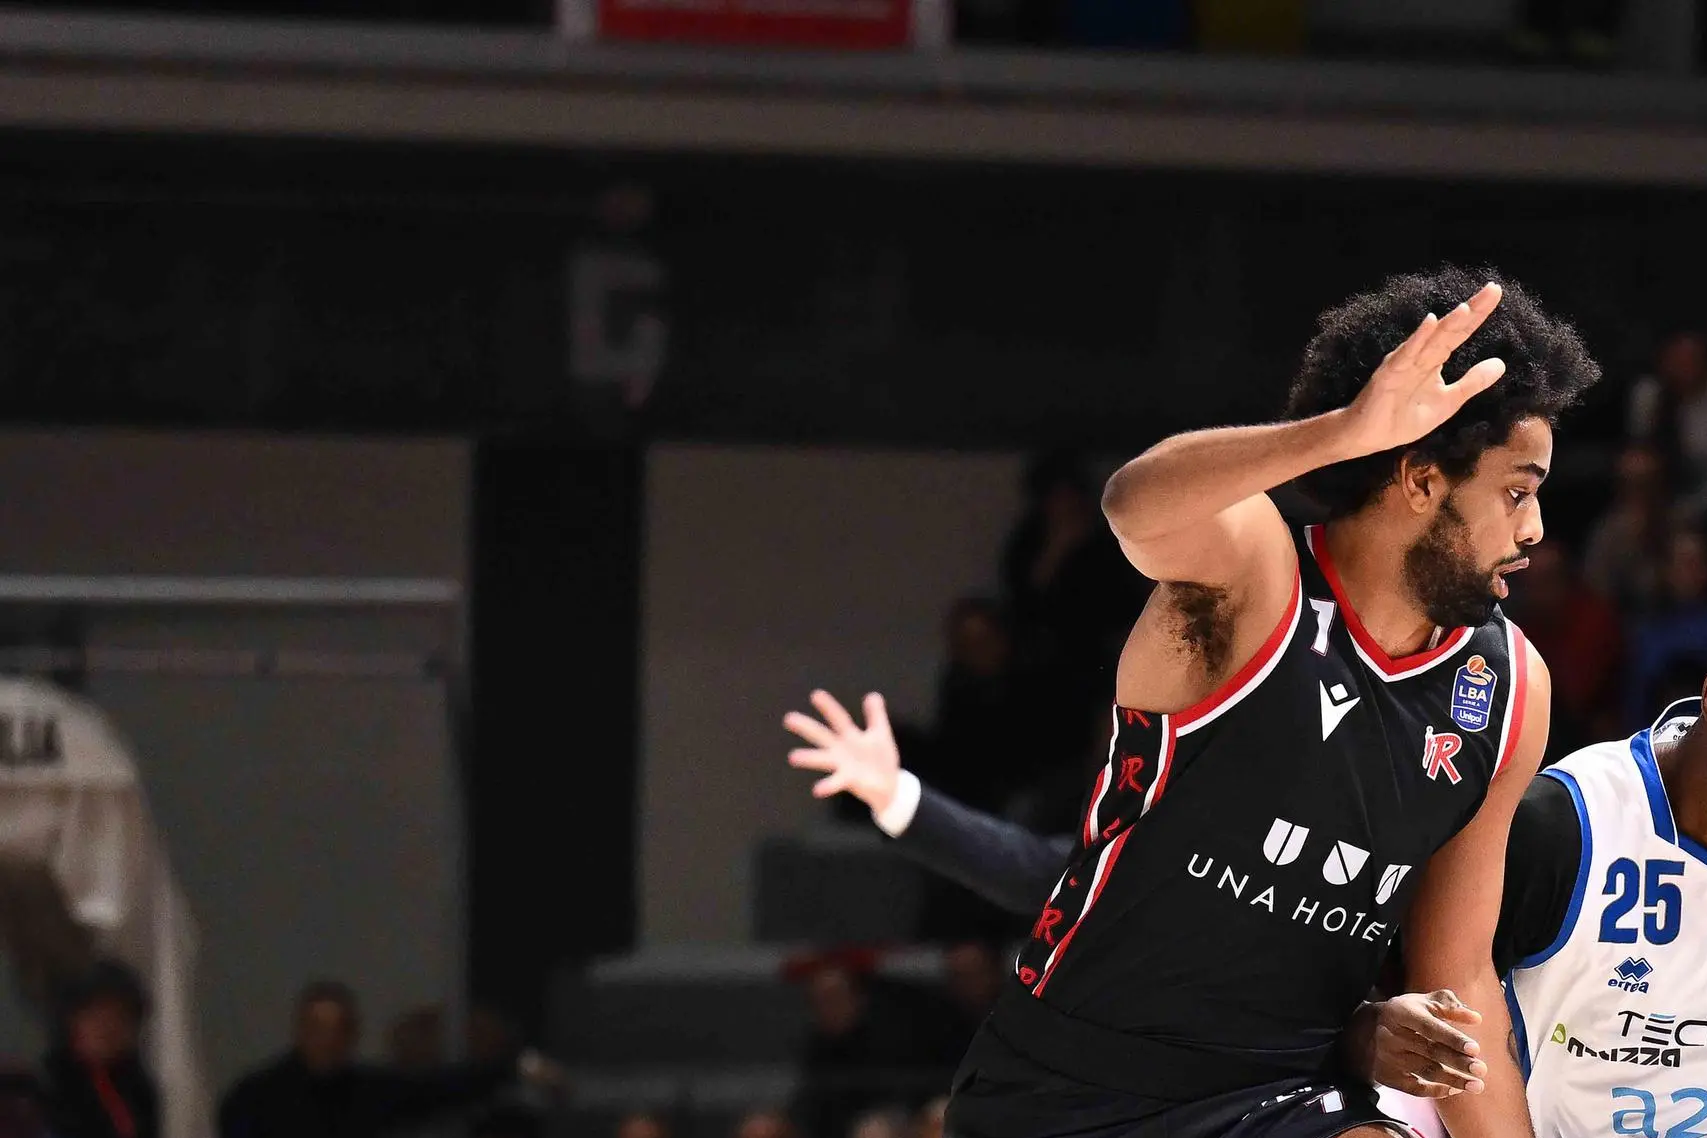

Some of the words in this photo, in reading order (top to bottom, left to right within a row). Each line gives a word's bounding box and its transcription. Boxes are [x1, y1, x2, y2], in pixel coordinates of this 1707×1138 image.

[1458, 686, 1487, 702] LBA
[1459, 709, 1482, 723] Unipol
[1187, 853, 1274, 913] UNA
[1598, 857, 1686, 945] 25
